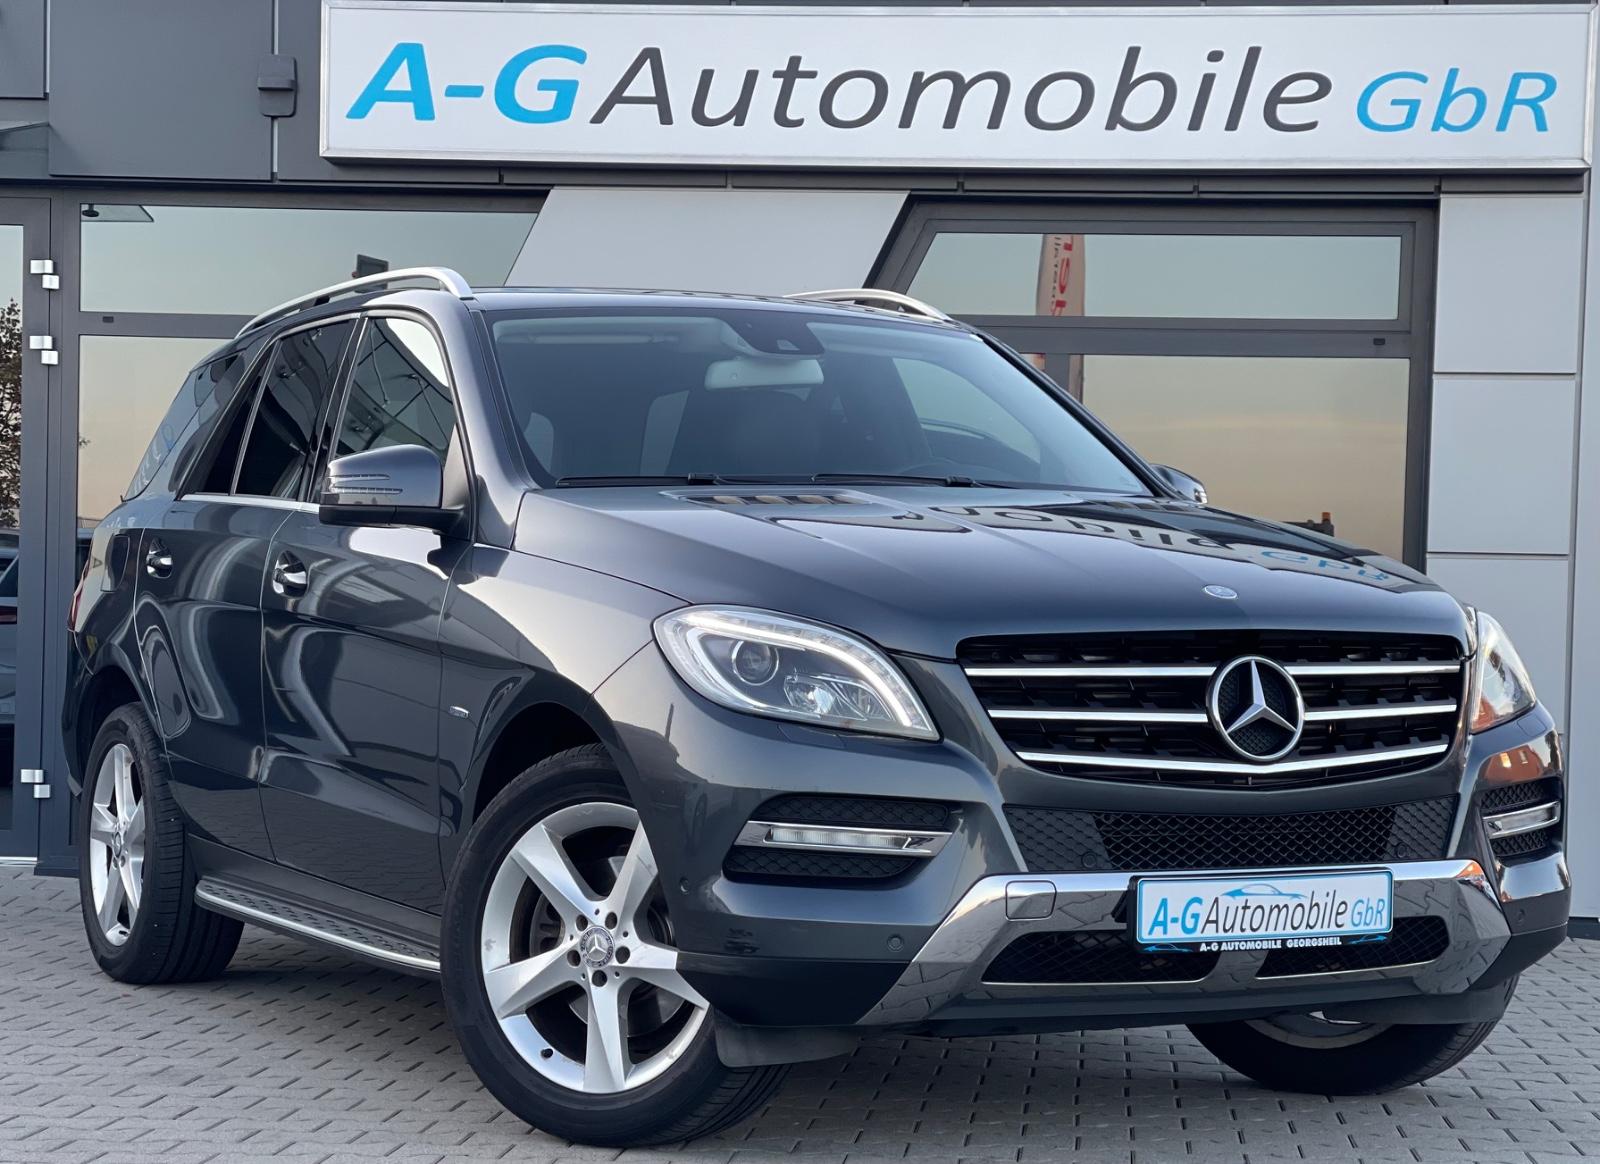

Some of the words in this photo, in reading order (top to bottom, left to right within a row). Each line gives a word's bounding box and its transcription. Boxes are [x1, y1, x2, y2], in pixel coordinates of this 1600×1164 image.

[345, 41, 588, 125] A-G
[588, 45, 1333, 133] Automobile
[1356, 67, 1558, 133] GbR
[1148, 896, 1203, 935] A-G
[1200, 889, 1348, 934] Automobile
[1350, 897, 1386, 928] GbR
[1199, 942, 1219, 952] A-G
[1220, 939, 1282, 951] AUTOMOBILE
[1286, 937, 1342, 949] GEORGSHEIL
